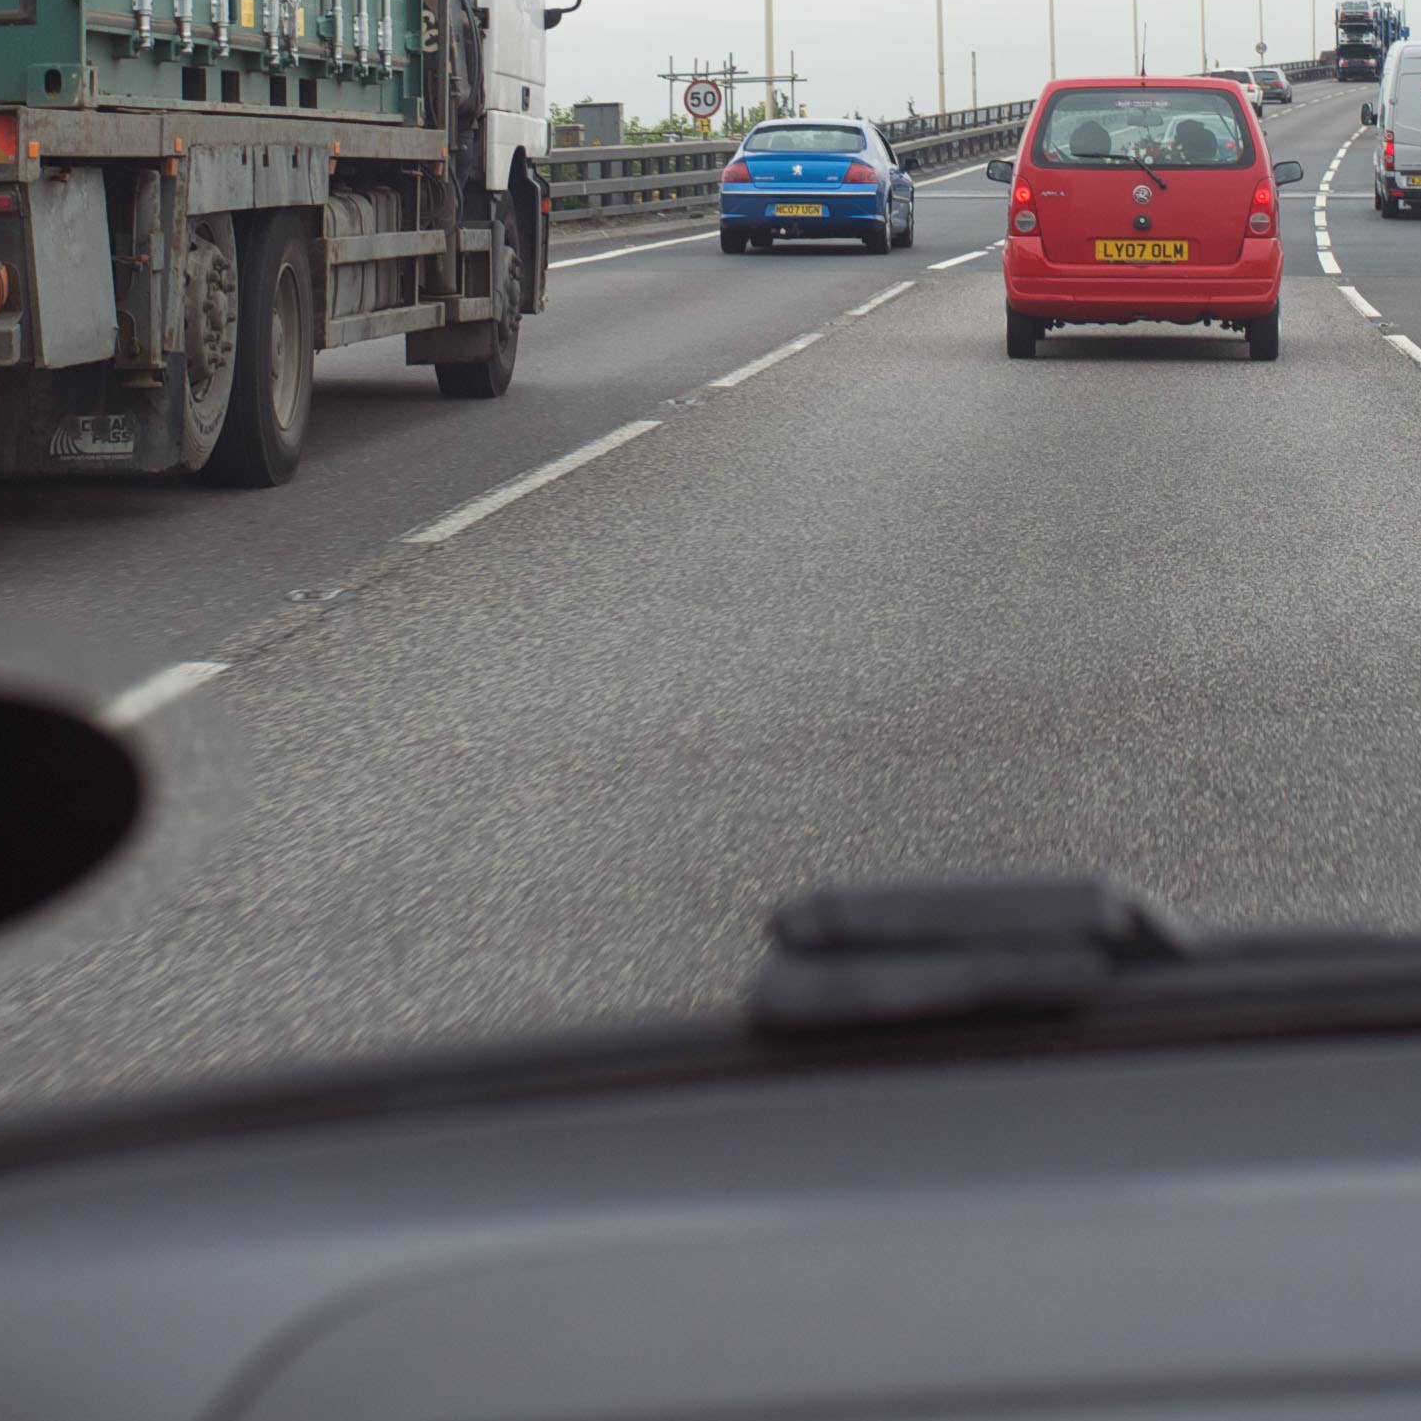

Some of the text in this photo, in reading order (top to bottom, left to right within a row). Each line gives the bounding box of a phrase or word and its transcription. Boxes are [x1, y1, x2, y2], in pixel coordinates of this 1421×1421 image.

[690, 91, 716, 107] 50
[1103, 243, 1184, 258] LY07 OLM
